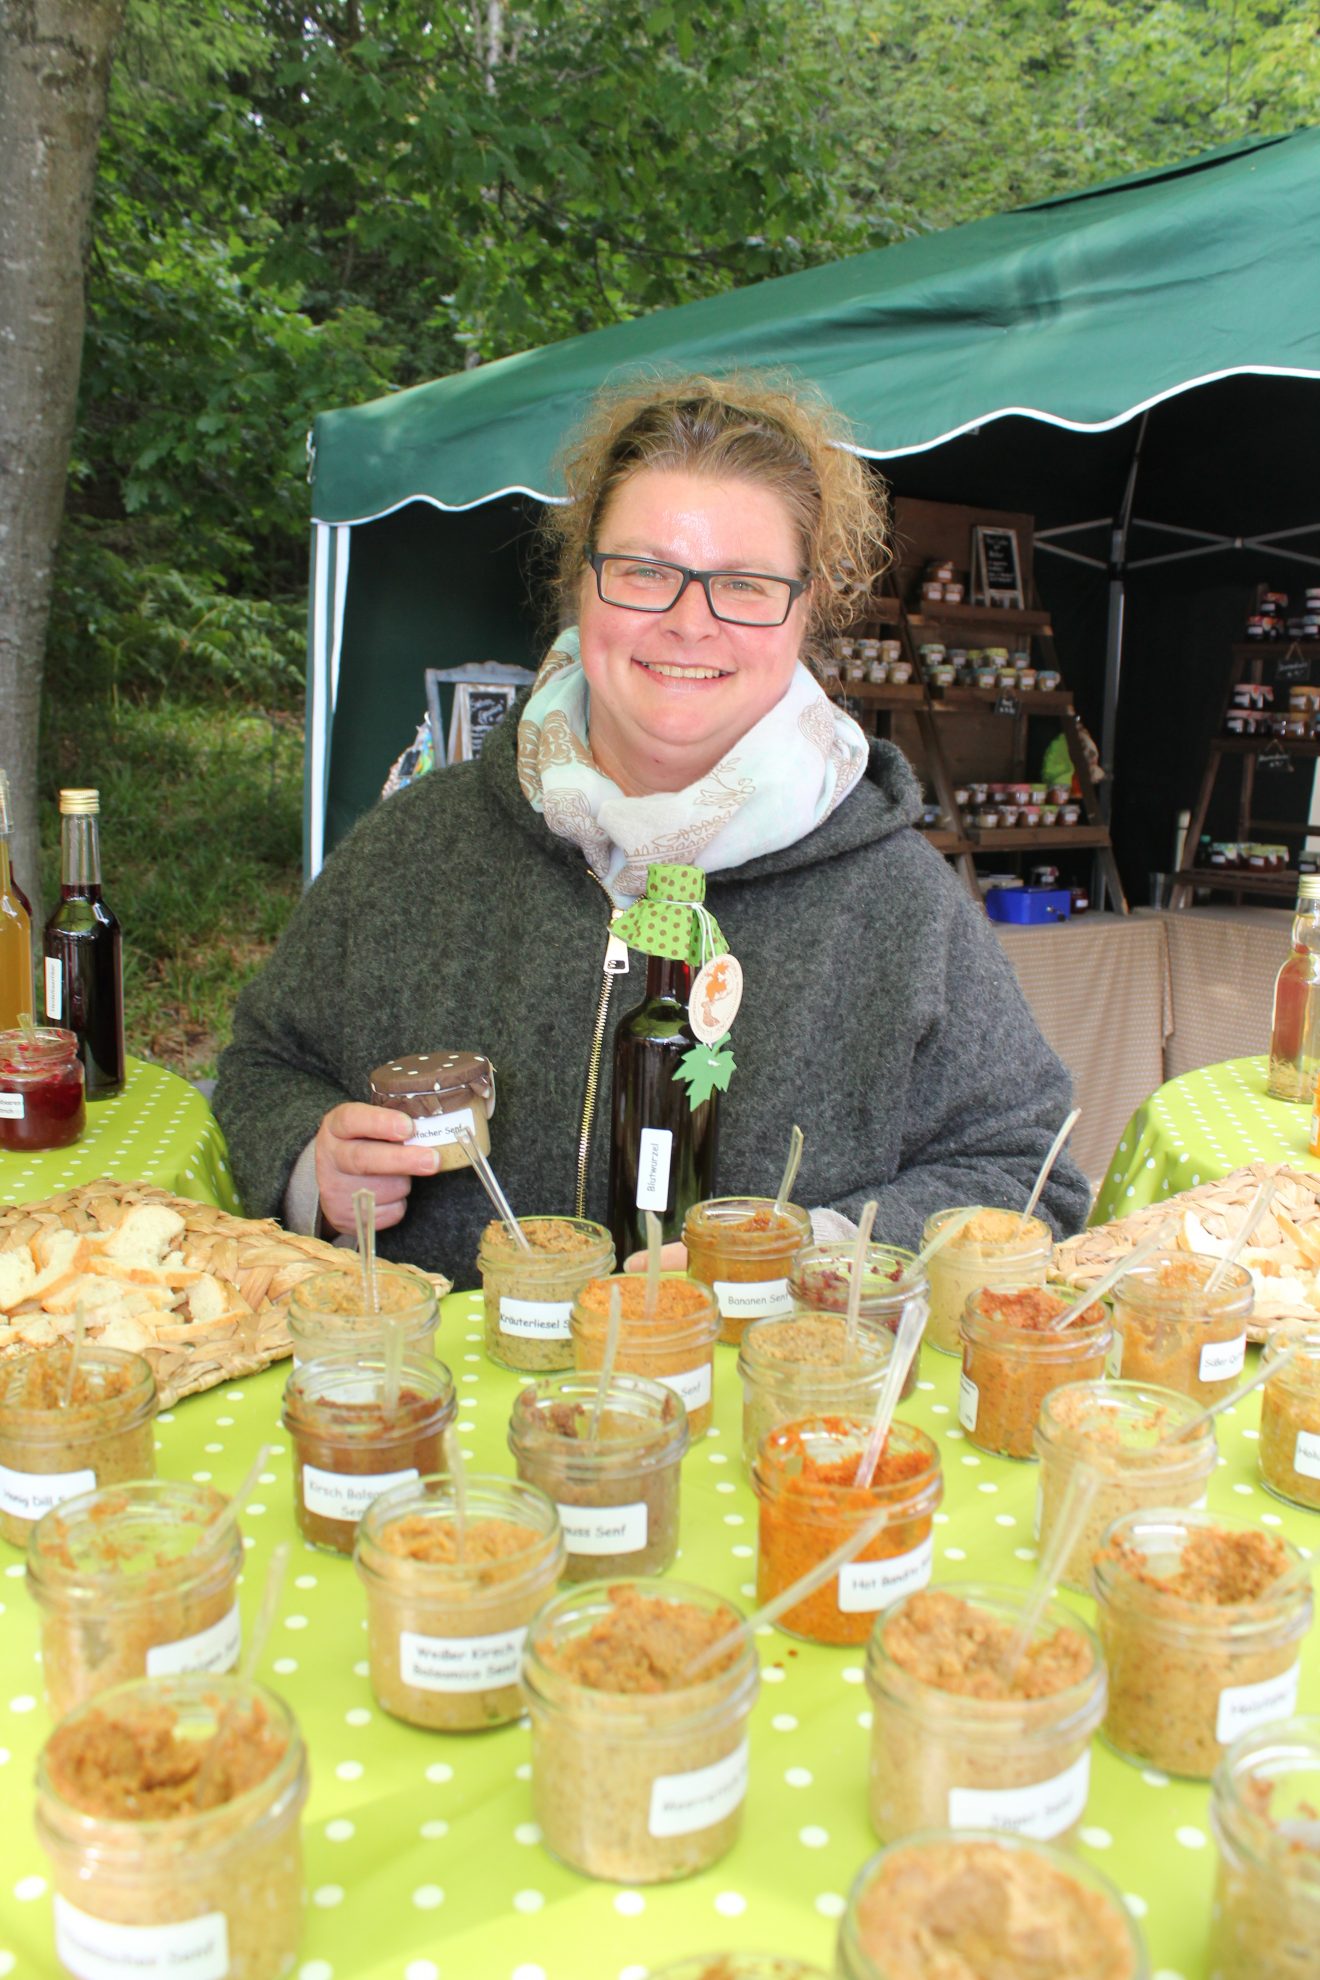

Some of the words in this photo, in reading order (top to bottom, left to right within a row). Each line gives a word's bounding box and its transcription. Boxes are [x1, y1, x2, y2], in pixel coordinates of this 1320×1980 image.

[412, 1128, 441, 1139] facher
[646, 1143, 659, 1192] Blutwurzel
[727, 1295, 767, 1306] Bananen
[500, 1312, 560, 1329] Kräuterliesel
[595, 1524, 626, 1538] Senf
